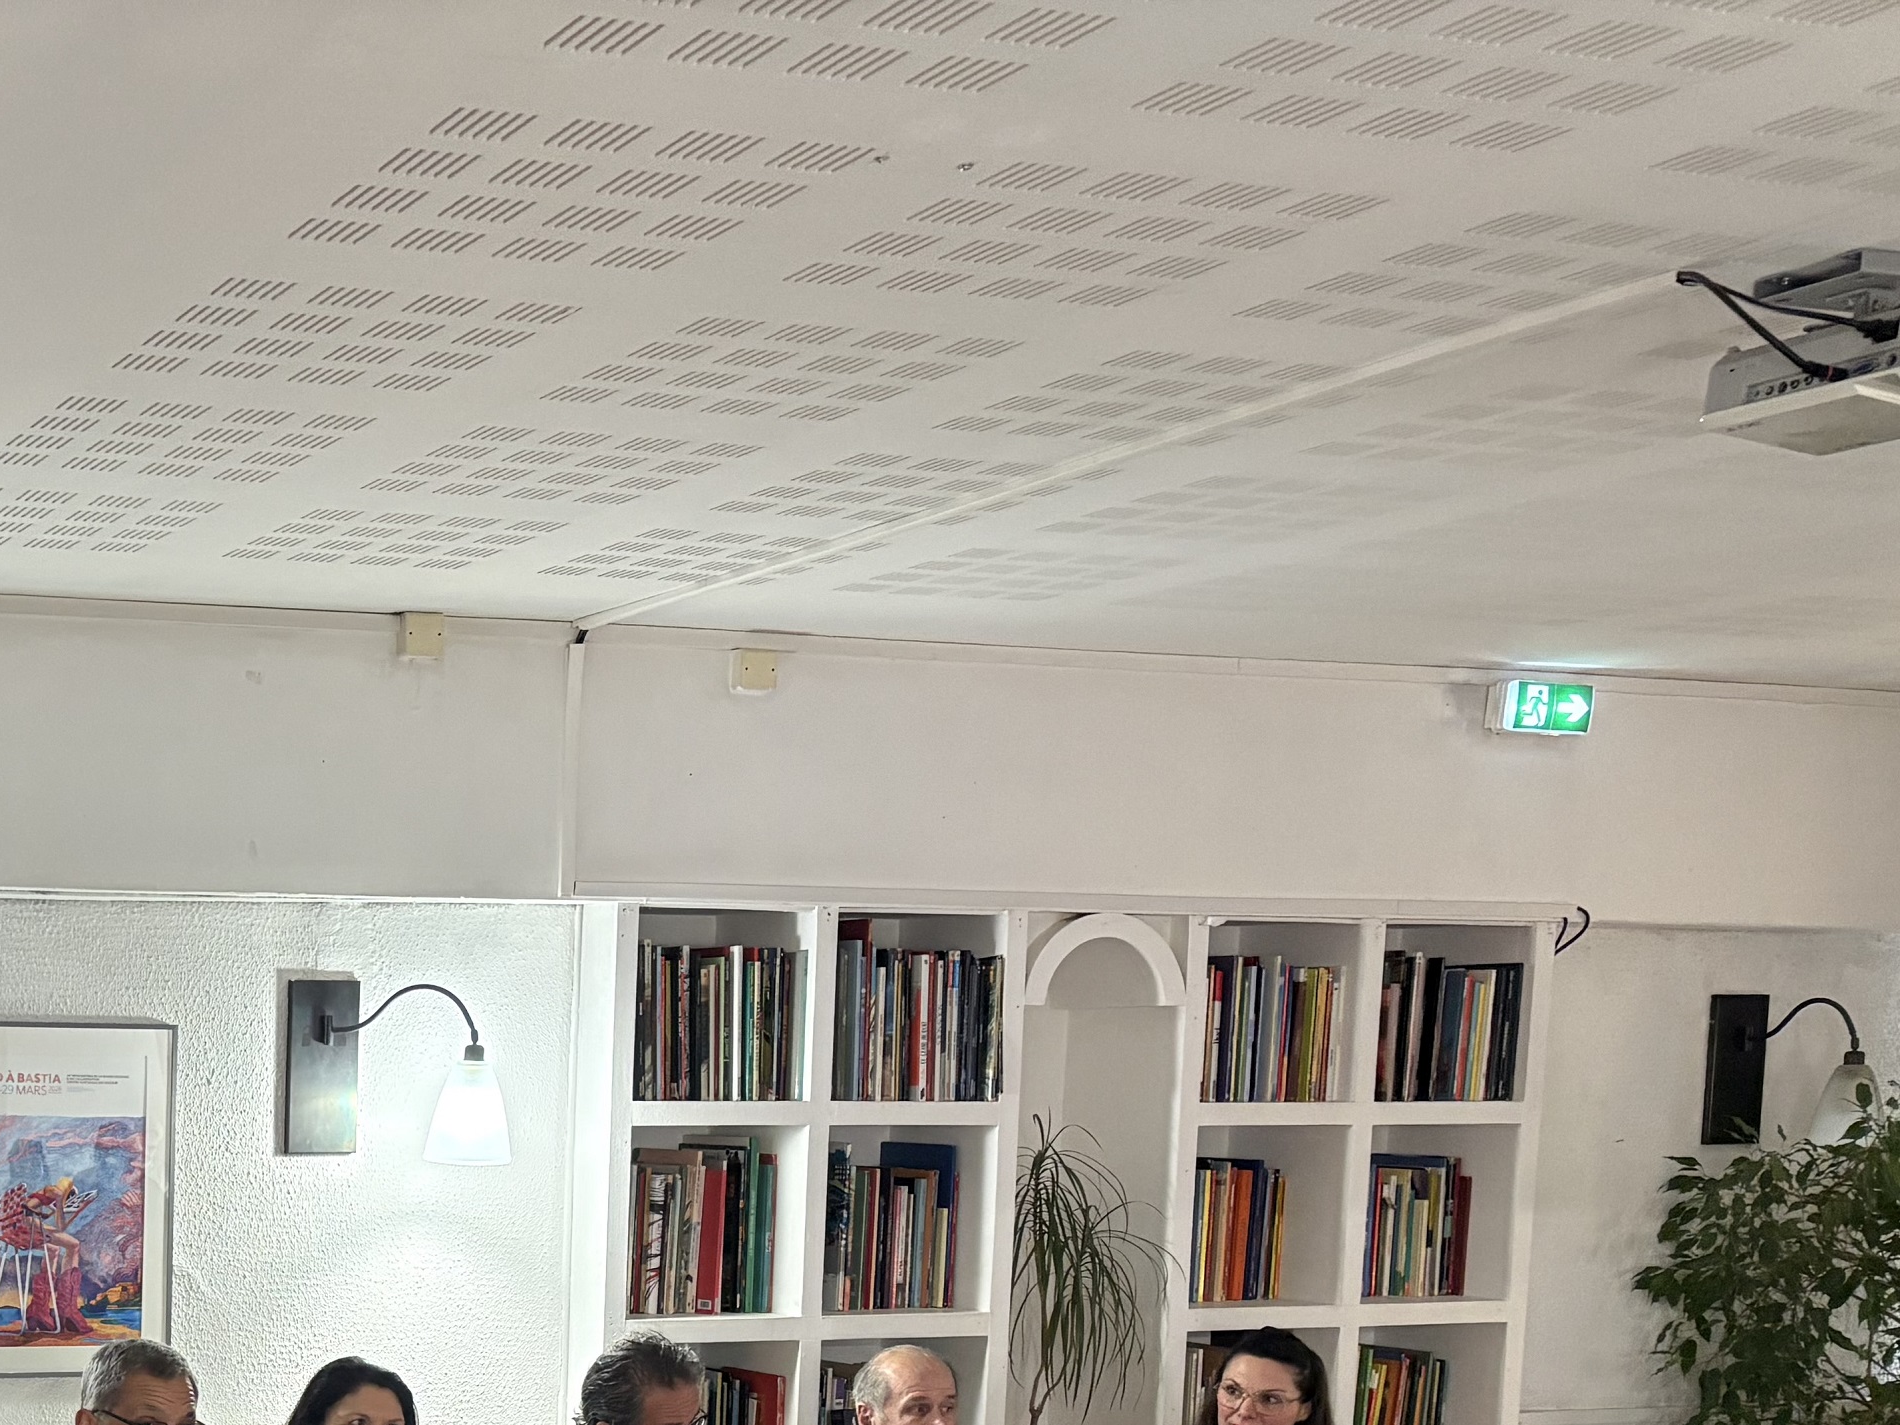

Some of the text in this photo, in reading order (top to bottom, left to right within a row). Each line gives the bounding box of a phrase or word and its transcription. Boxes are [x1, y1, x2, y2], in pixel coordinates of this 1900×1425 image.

[5, 1069, 15, 1083] À
[17, 1072, 62, 1084] BASTIA
[15, 1084, 47, 1096] MARS
